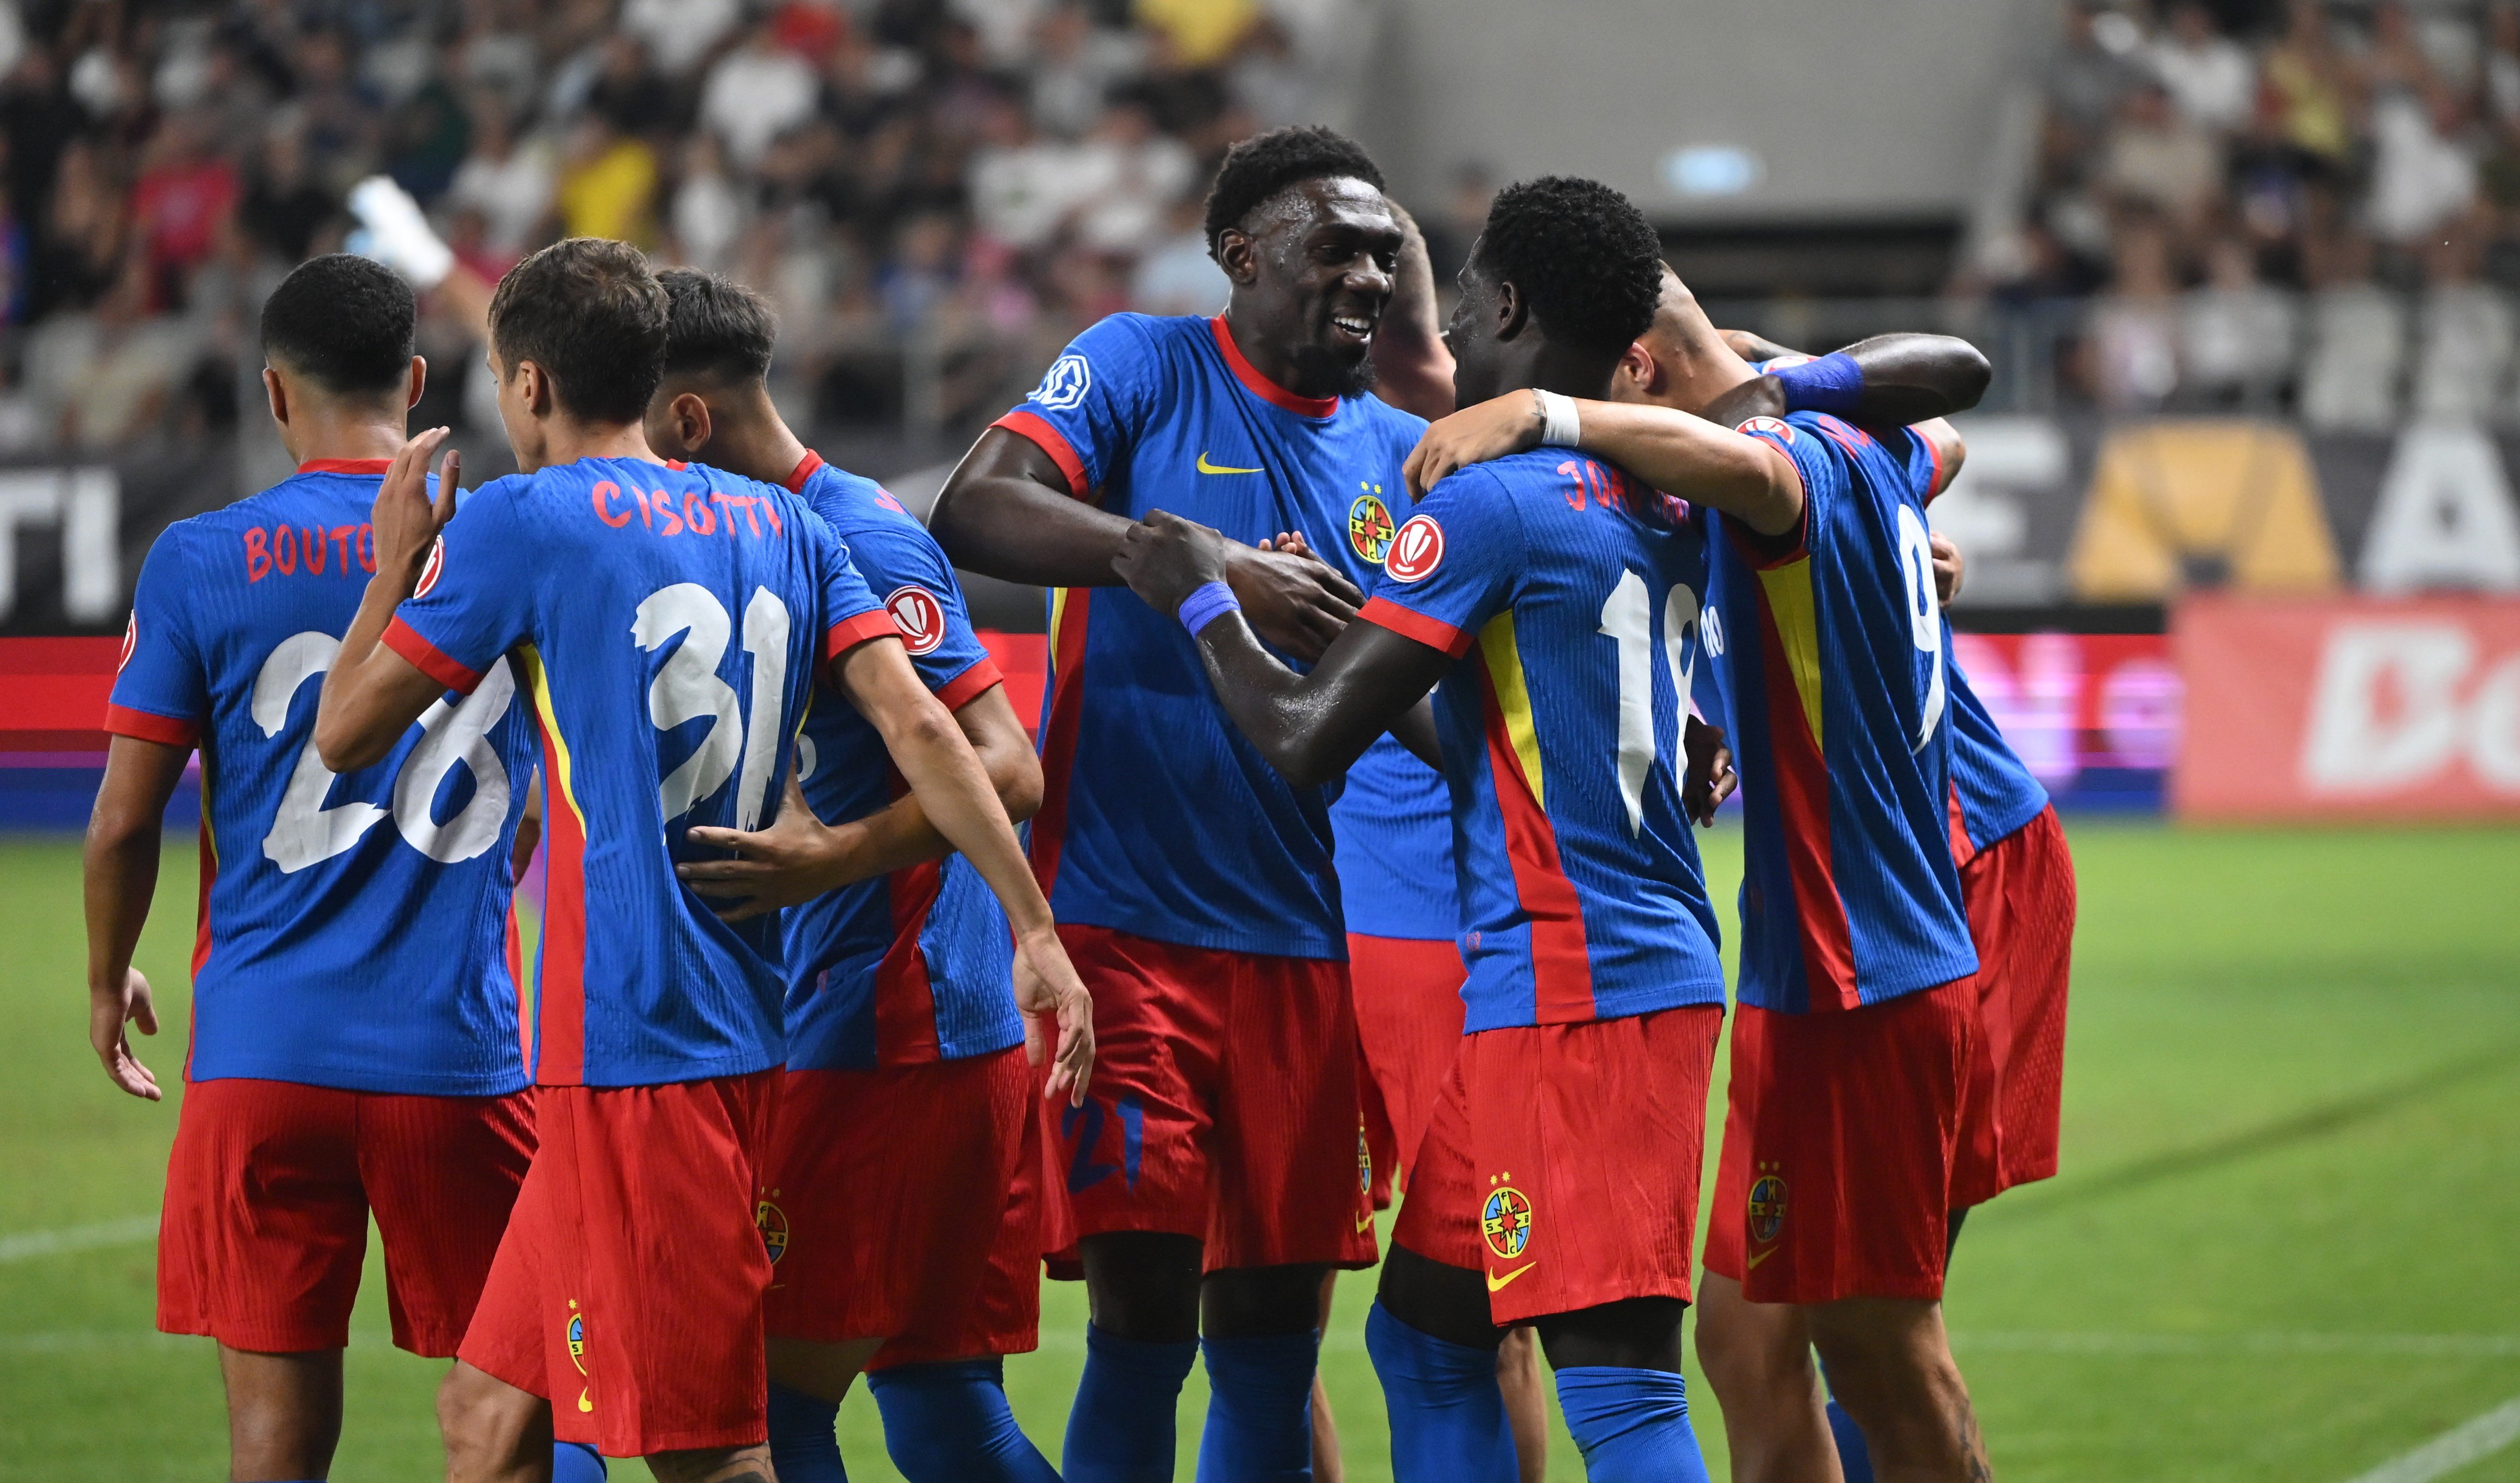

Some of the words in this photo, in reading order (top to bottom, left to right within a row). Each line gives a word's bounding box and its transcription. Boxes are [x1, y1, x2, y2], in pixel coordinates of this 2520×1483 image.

[592, 481, 782, 540] CISOTTI
[1898, 504, 1945, 756] 9
[630, 582, 790, 850] 31
[1061, 1093, 1143, 1196] 21
[1486, 1222, 1493, 1232] S
[572, 1344, 579, 1352] S
